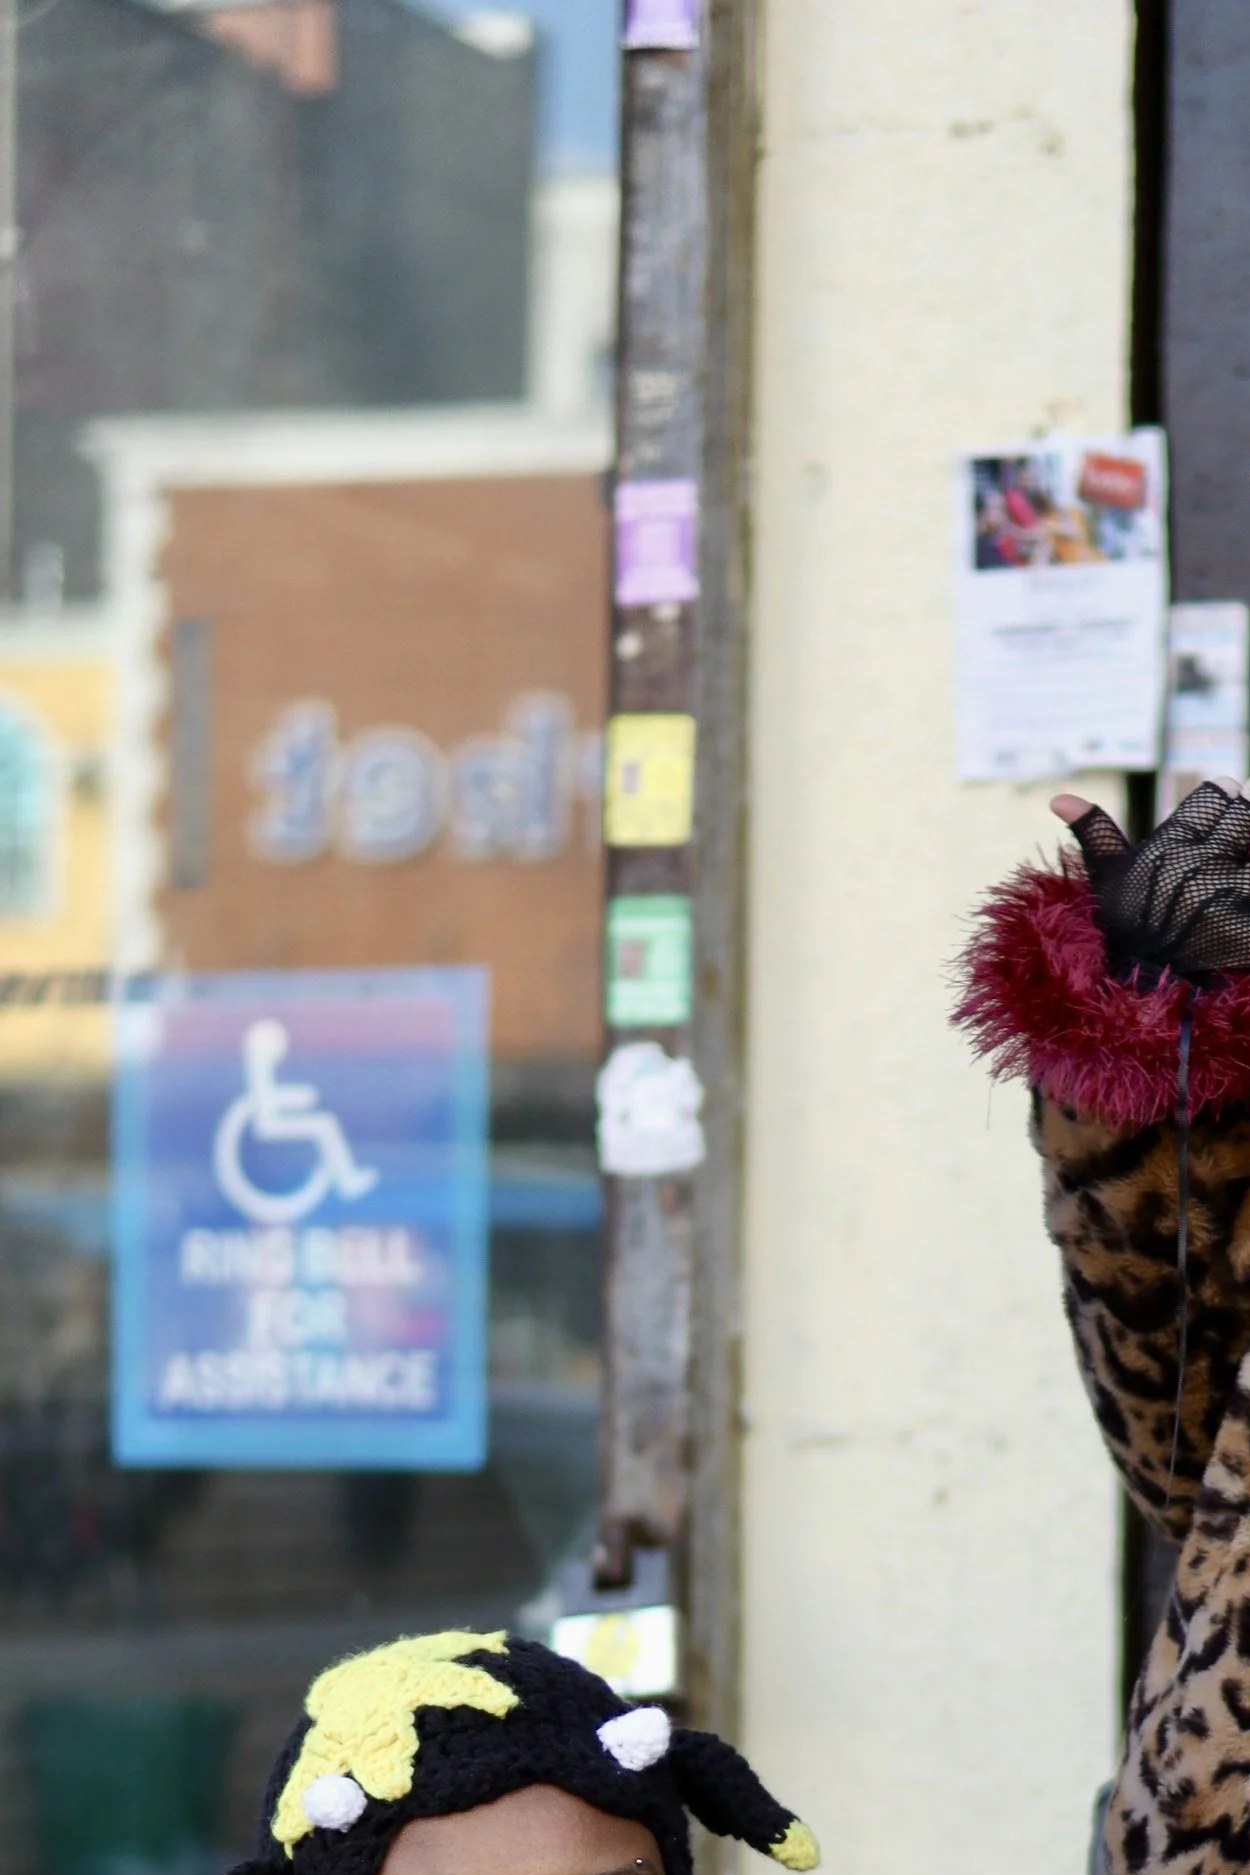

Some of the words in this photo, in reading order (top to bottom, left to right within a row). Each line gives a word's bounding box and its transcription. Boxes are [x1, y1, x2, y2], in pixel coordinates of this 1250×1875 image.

[180, 1228, 295, 1287] RING
[302, 1227, 424, 1287] BELL
[247, 1288, 349, 1349] FOR
[157, 1349, 437, 1412] ASSISTANCE
